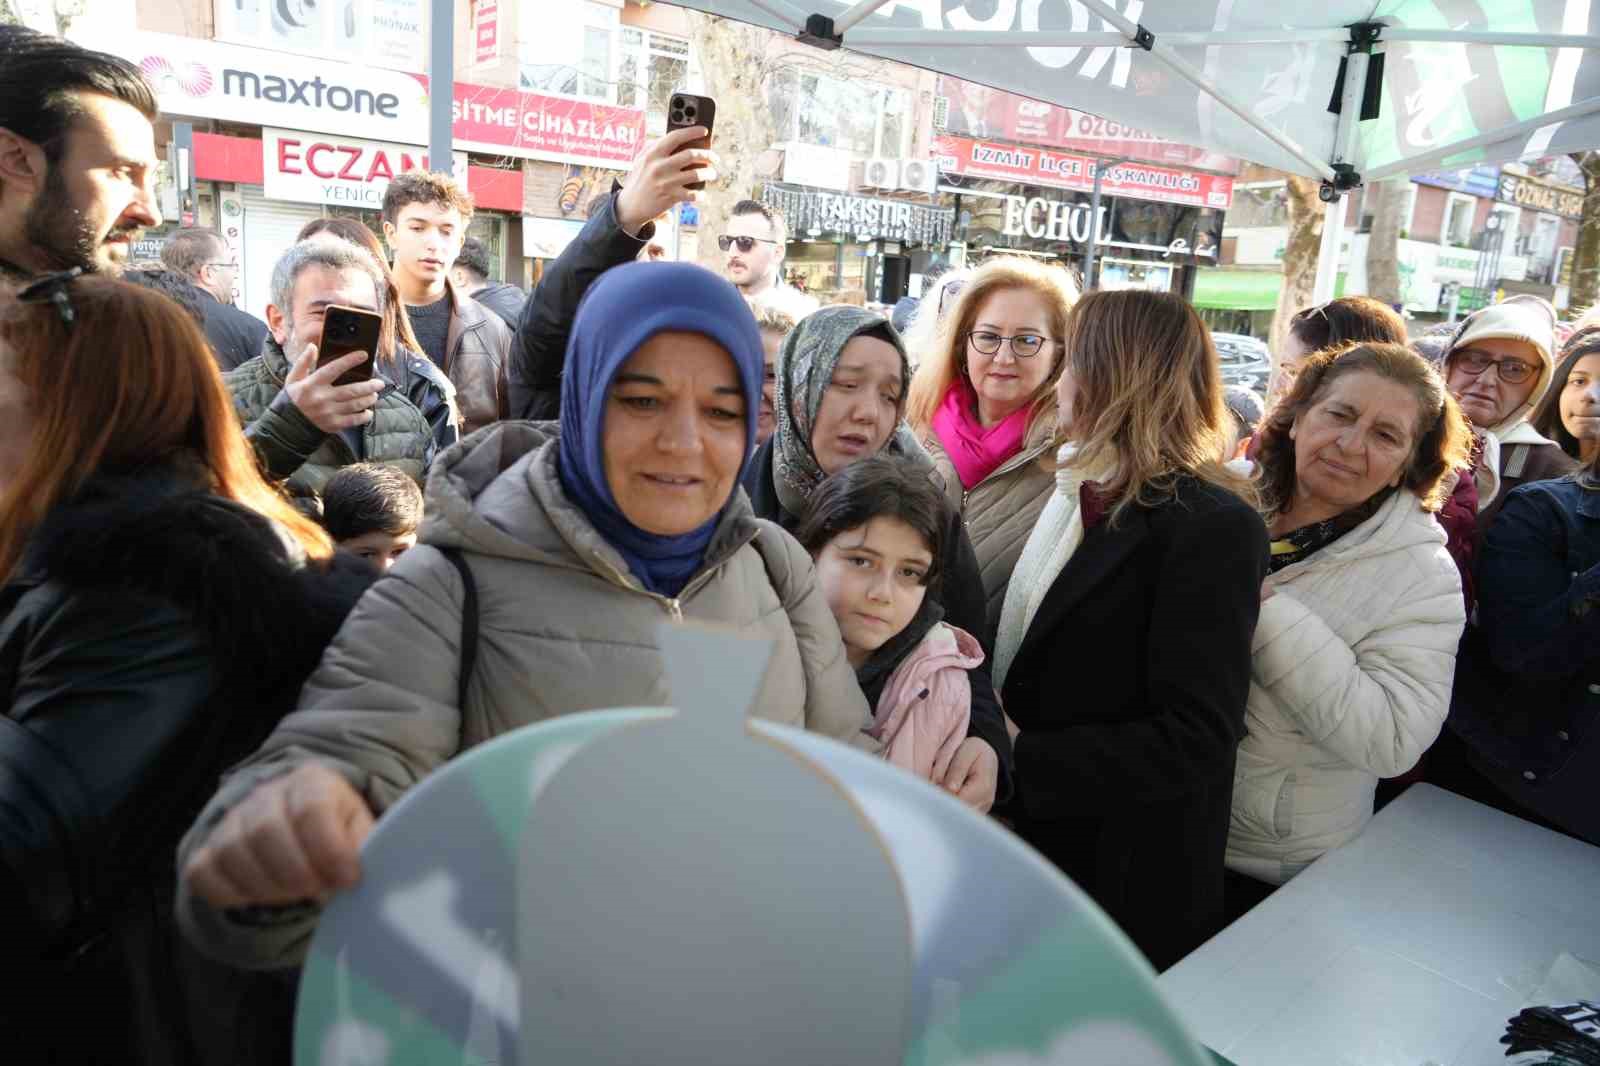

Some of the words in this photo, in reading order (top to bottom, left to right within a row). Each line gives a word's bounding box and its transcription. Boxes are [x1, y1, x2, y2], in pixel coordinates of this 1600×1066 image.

[223, 68, 400, 118] maxtone
[523, 110, 636, 144] CİHAZLARI
[278, 138, 430, 182] ECZAN
[972, 144, 1032, 168] İZMİT
[1039, 153, 1082, 178] İLÇE
